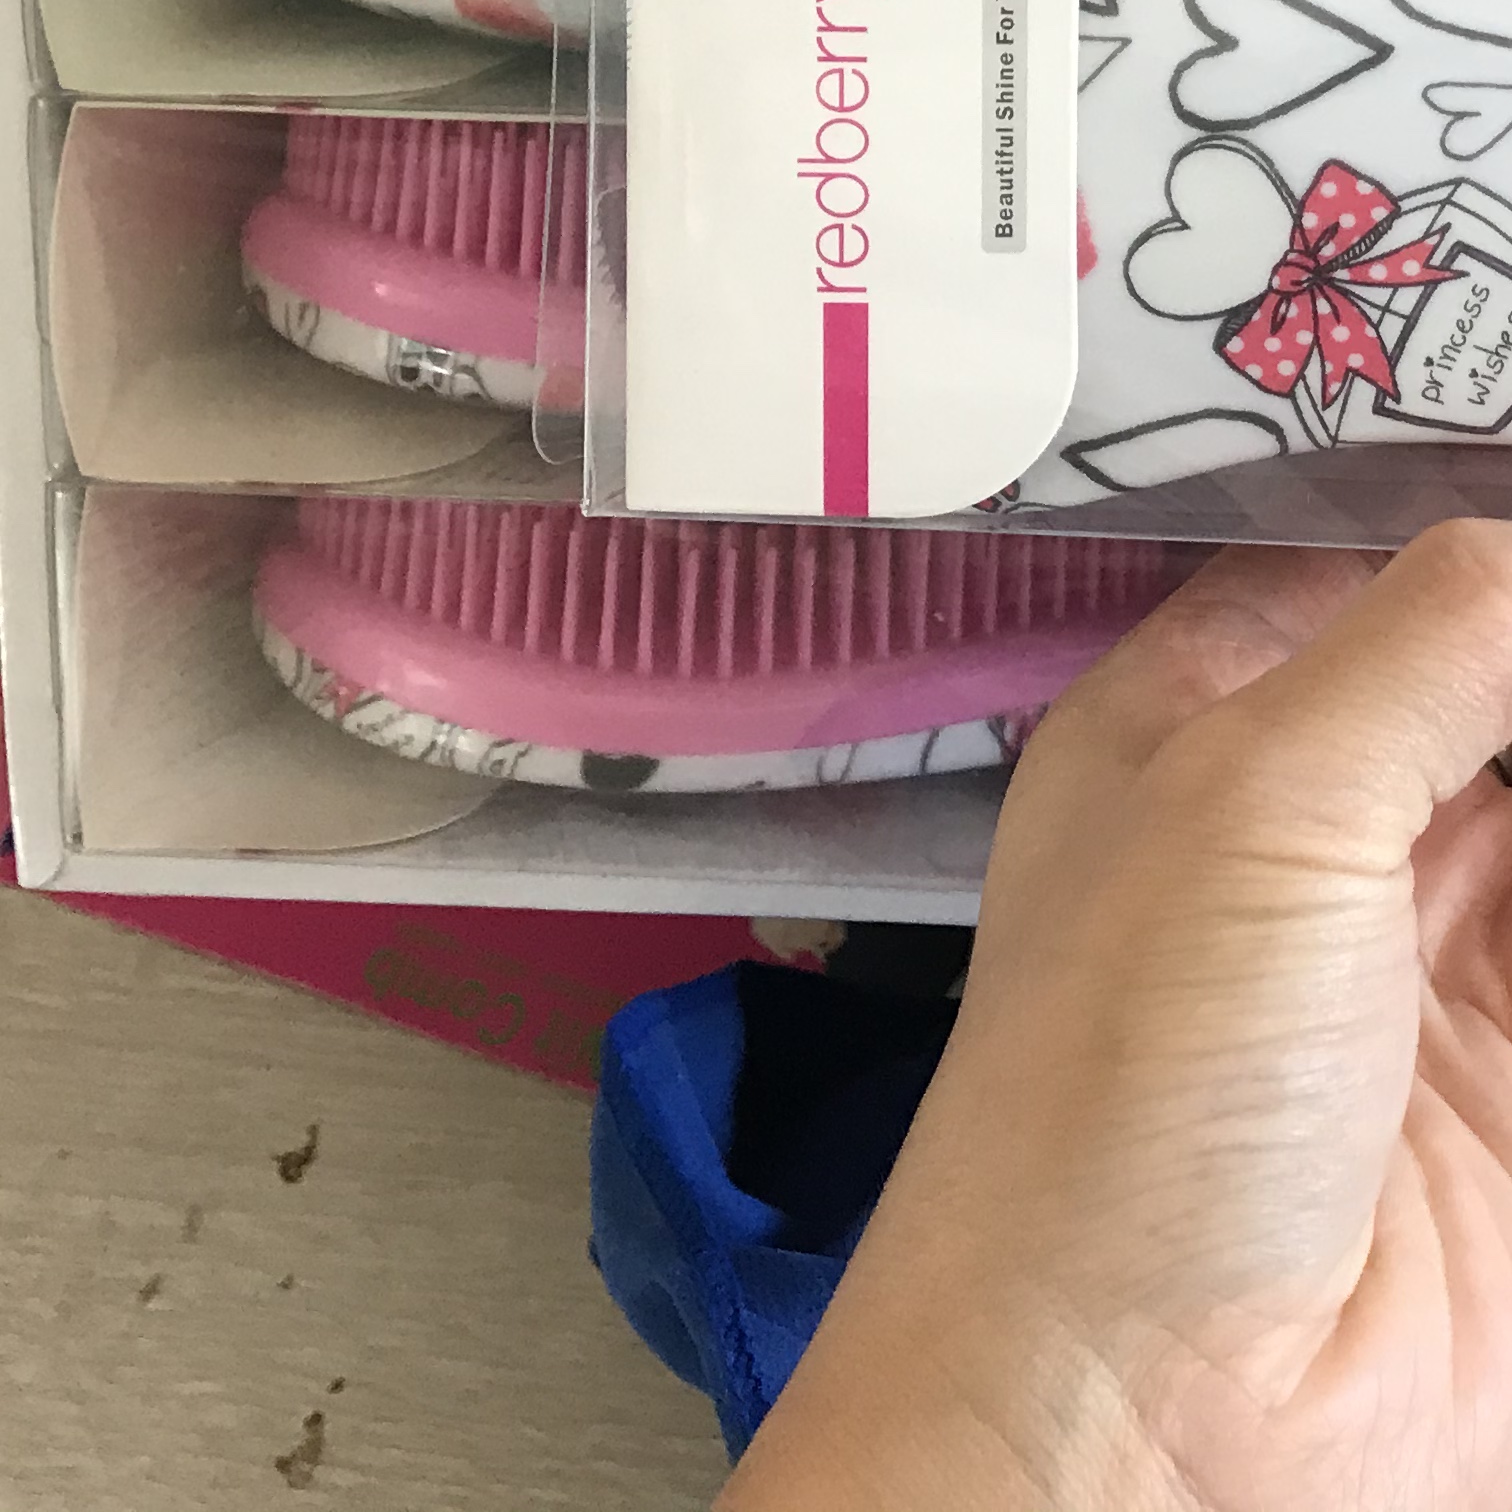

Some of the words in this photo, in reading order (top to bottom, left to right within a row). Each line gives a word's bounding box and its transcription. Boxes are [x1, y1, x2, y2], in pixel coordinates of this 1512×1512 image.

[995, 6, 1015, 46] For
[994, 51, 1015, 121] Shine
[994, 127, 1015, 239] Beautiful
[1420, 282, 1491, 406] princess
